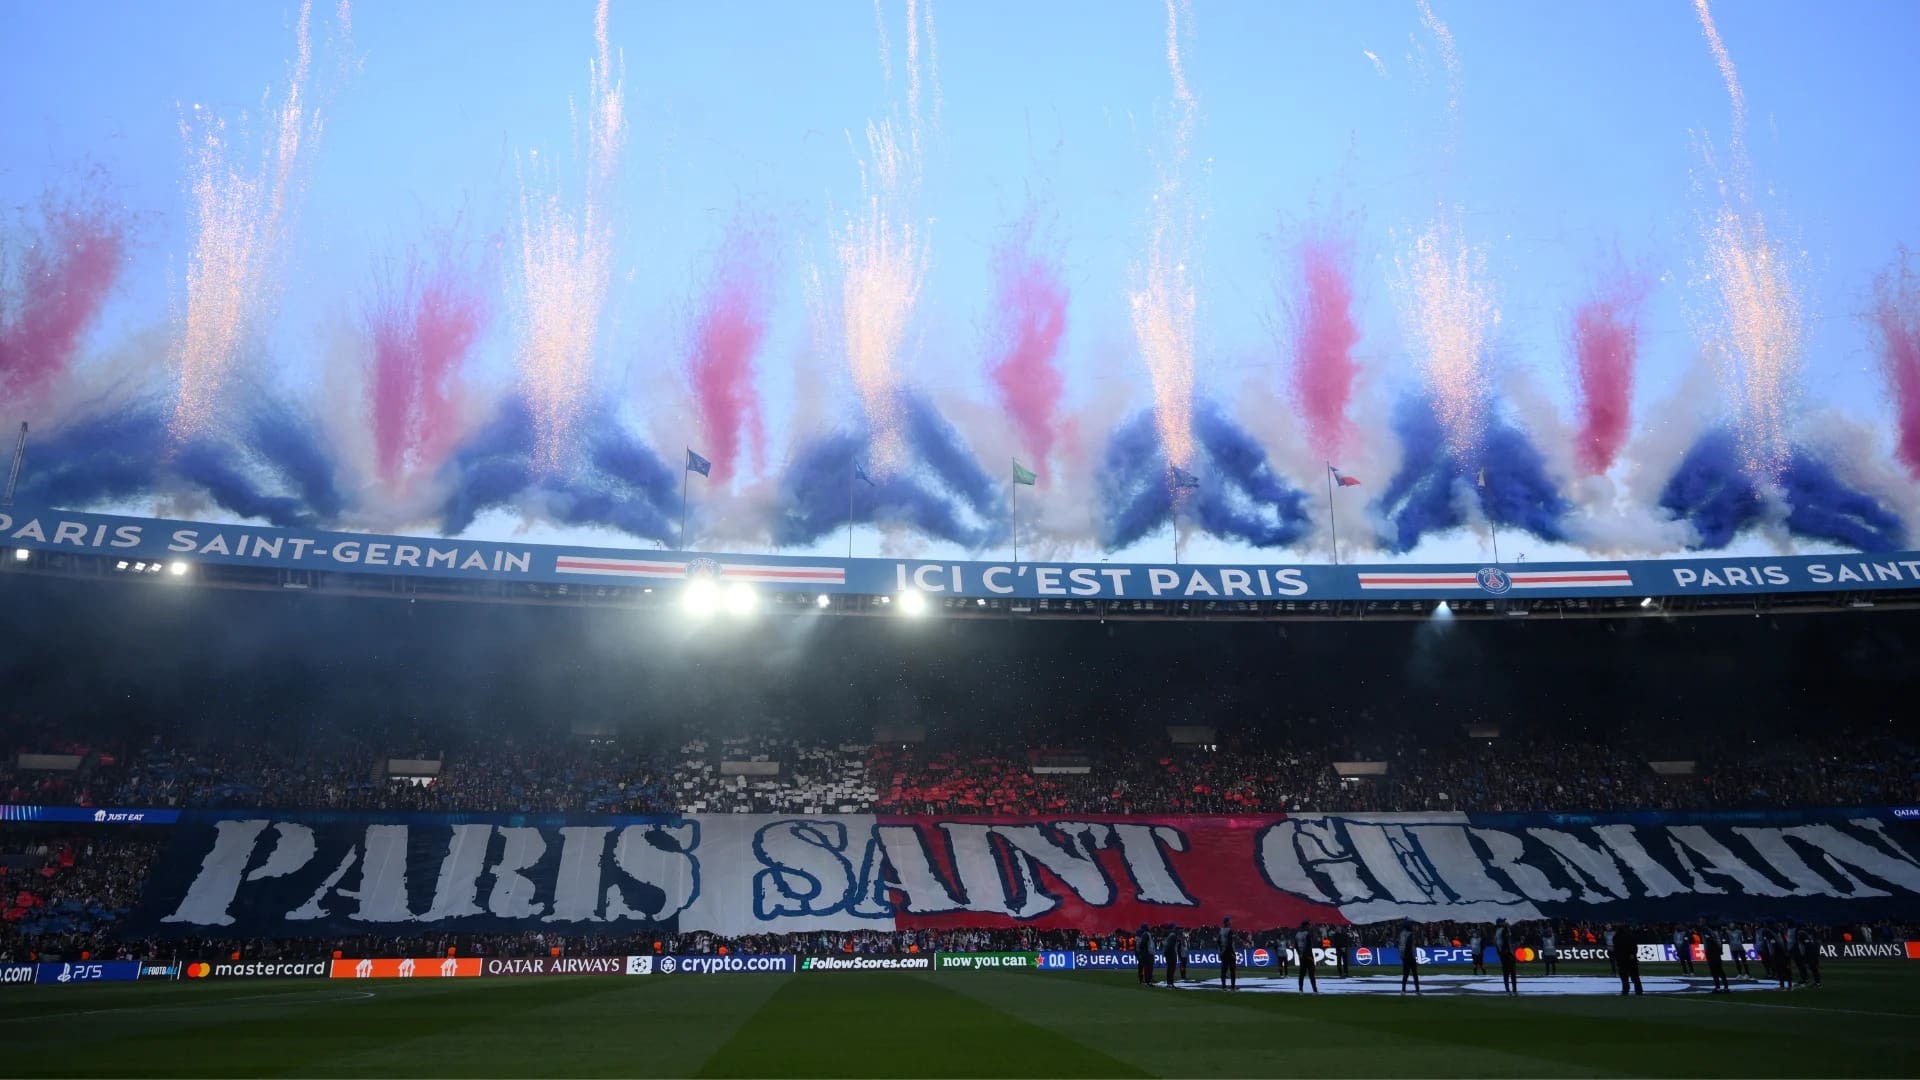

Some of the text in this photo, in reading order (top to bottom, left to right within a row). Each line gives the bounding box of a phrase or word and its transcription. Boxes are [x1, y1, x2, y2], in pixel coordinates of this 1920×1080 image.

[168, 530, 531, 572] SAINT-GERMAIN
[896, 564, 962, 593] ICI
[1149, 569, 1308, 597] PARIS
[1673, 561, 1920, 588] PARIS SAINT
[1894, 809, 1920, 817] QATAR
[160, 817, 1920, 926] PARIS SAINT GERMAIN
[1282, 948, 1344, 966] PPS
[1433, 949, 1473, 962] PS5
[1538, 946, 1610, 960] asterc
[1843, 943, 1901, 957] AIRWAYS
[488, 958, 620, 973] QATAR AIRWAYS
[681, 956, 786, 974] crypto.com
[809, 957, 928, 969] FollowScores.com
[943, 956, 1027, 969] now you can
[1090, 955, 1119, 965] UEFA
[1188, 954, 1223, 964] LEAGU
[0, 966, 32, 982] .com
[73, 965, 103, 978] PS5
[215, 960, 325, 976] mastercard
